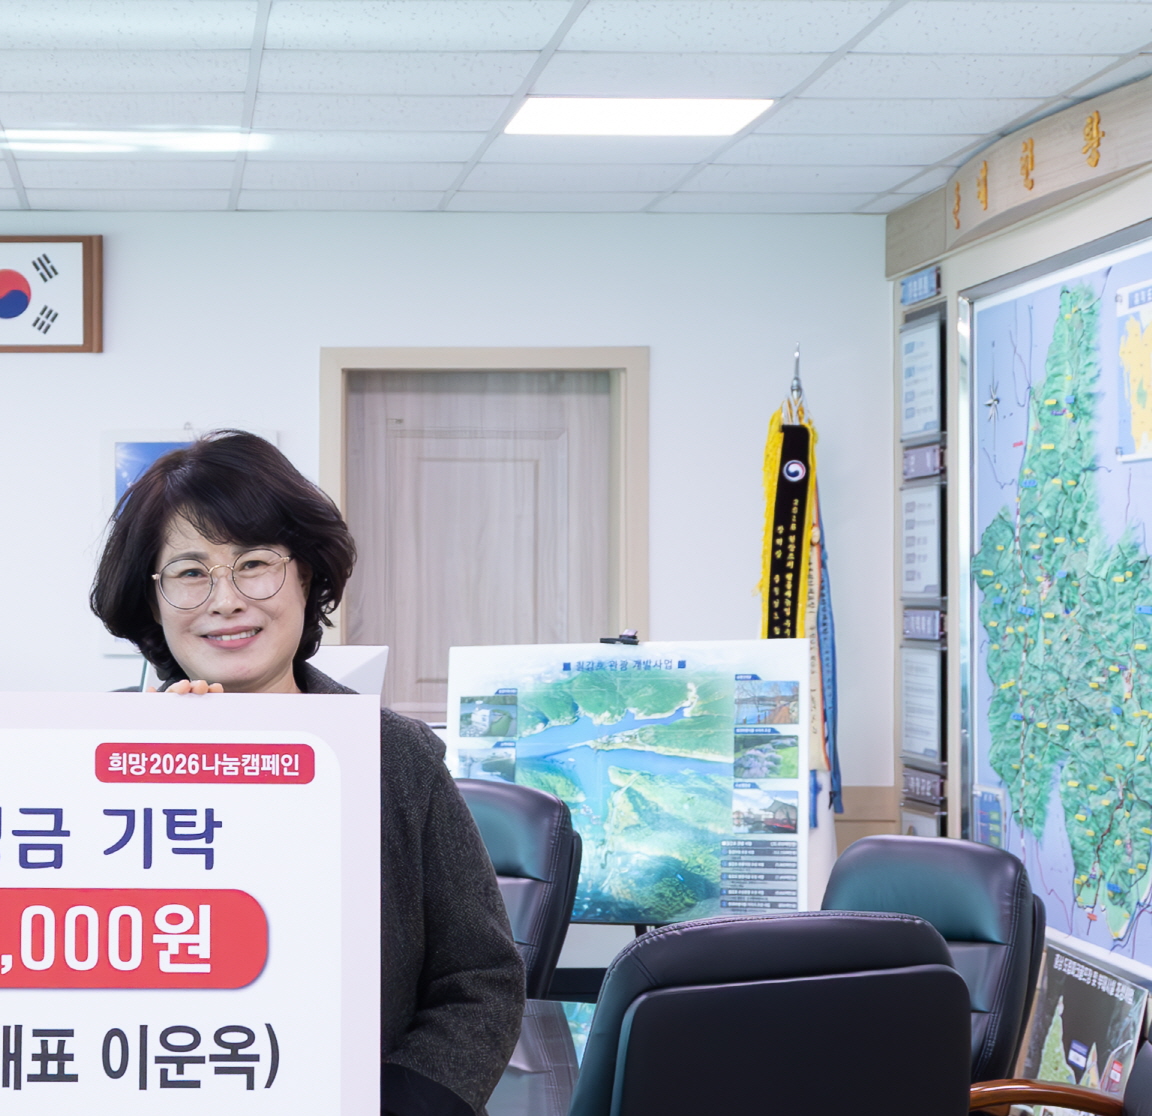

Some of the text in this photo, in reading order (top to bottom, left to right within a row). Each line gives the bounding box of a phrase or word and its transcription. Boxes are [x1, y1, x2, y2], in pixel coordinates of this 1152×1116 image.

[107, 752, 300, 776] 희망2026나눔캠페인
[102, 807, 223, 871] 기탁
[101, 1022, 281, 1092] 이운옥)
